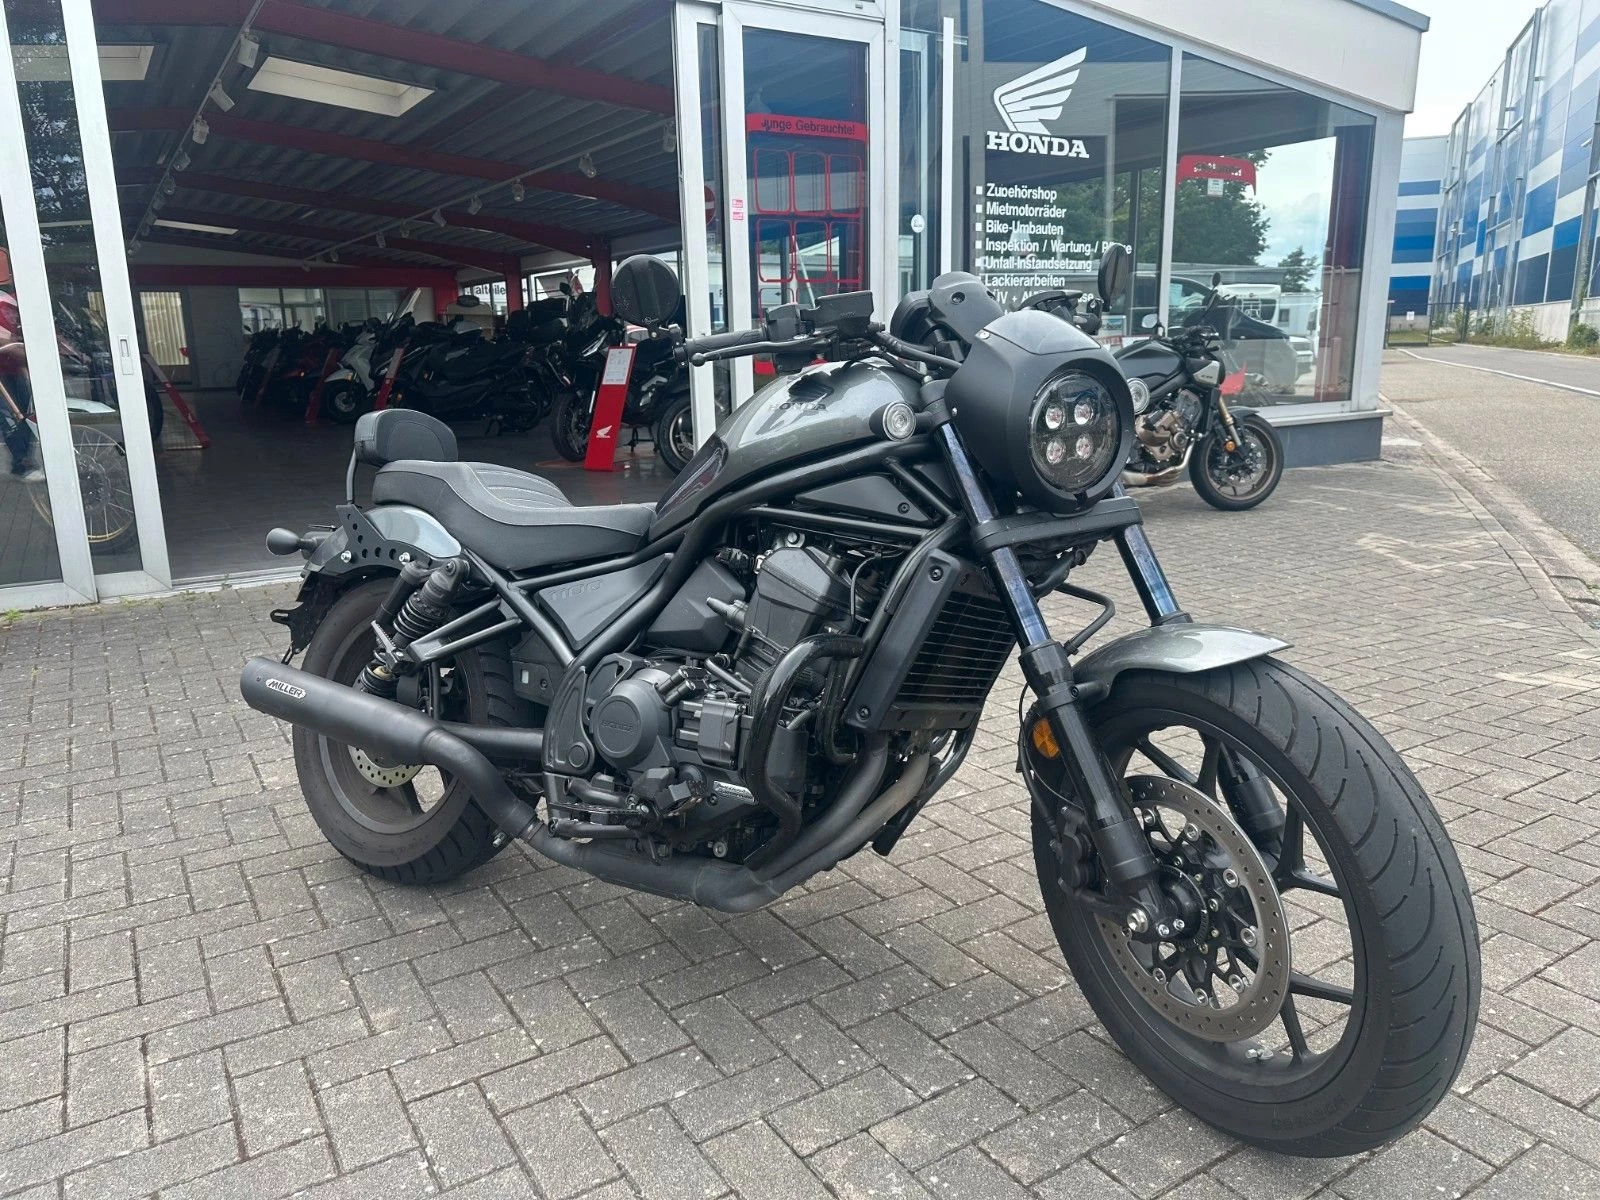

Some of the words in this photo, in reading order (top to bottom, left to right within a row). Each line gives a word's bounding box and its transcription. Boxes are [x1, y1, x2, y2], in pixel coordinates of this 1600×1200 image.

[795, 120, 855, 136] Gebrauchte!
[986, 130, 1090, 158] HONDA
[986, 183, 1057, 203] Zubehörshop
[986, 201, 1067, 218] Mietmotorräder
[985, 219, 1064, 235] Bike-Umbauten
[985, 238, 1039, 254] Inspektion
[1050, 240, 1091, 255] Wartung
[985, 255, 1092, 272] Unfall-Instandsetzung
[984, 274, 1066, 287] Lackierarbeiten
[268, 680, 303, 697] MILLER
